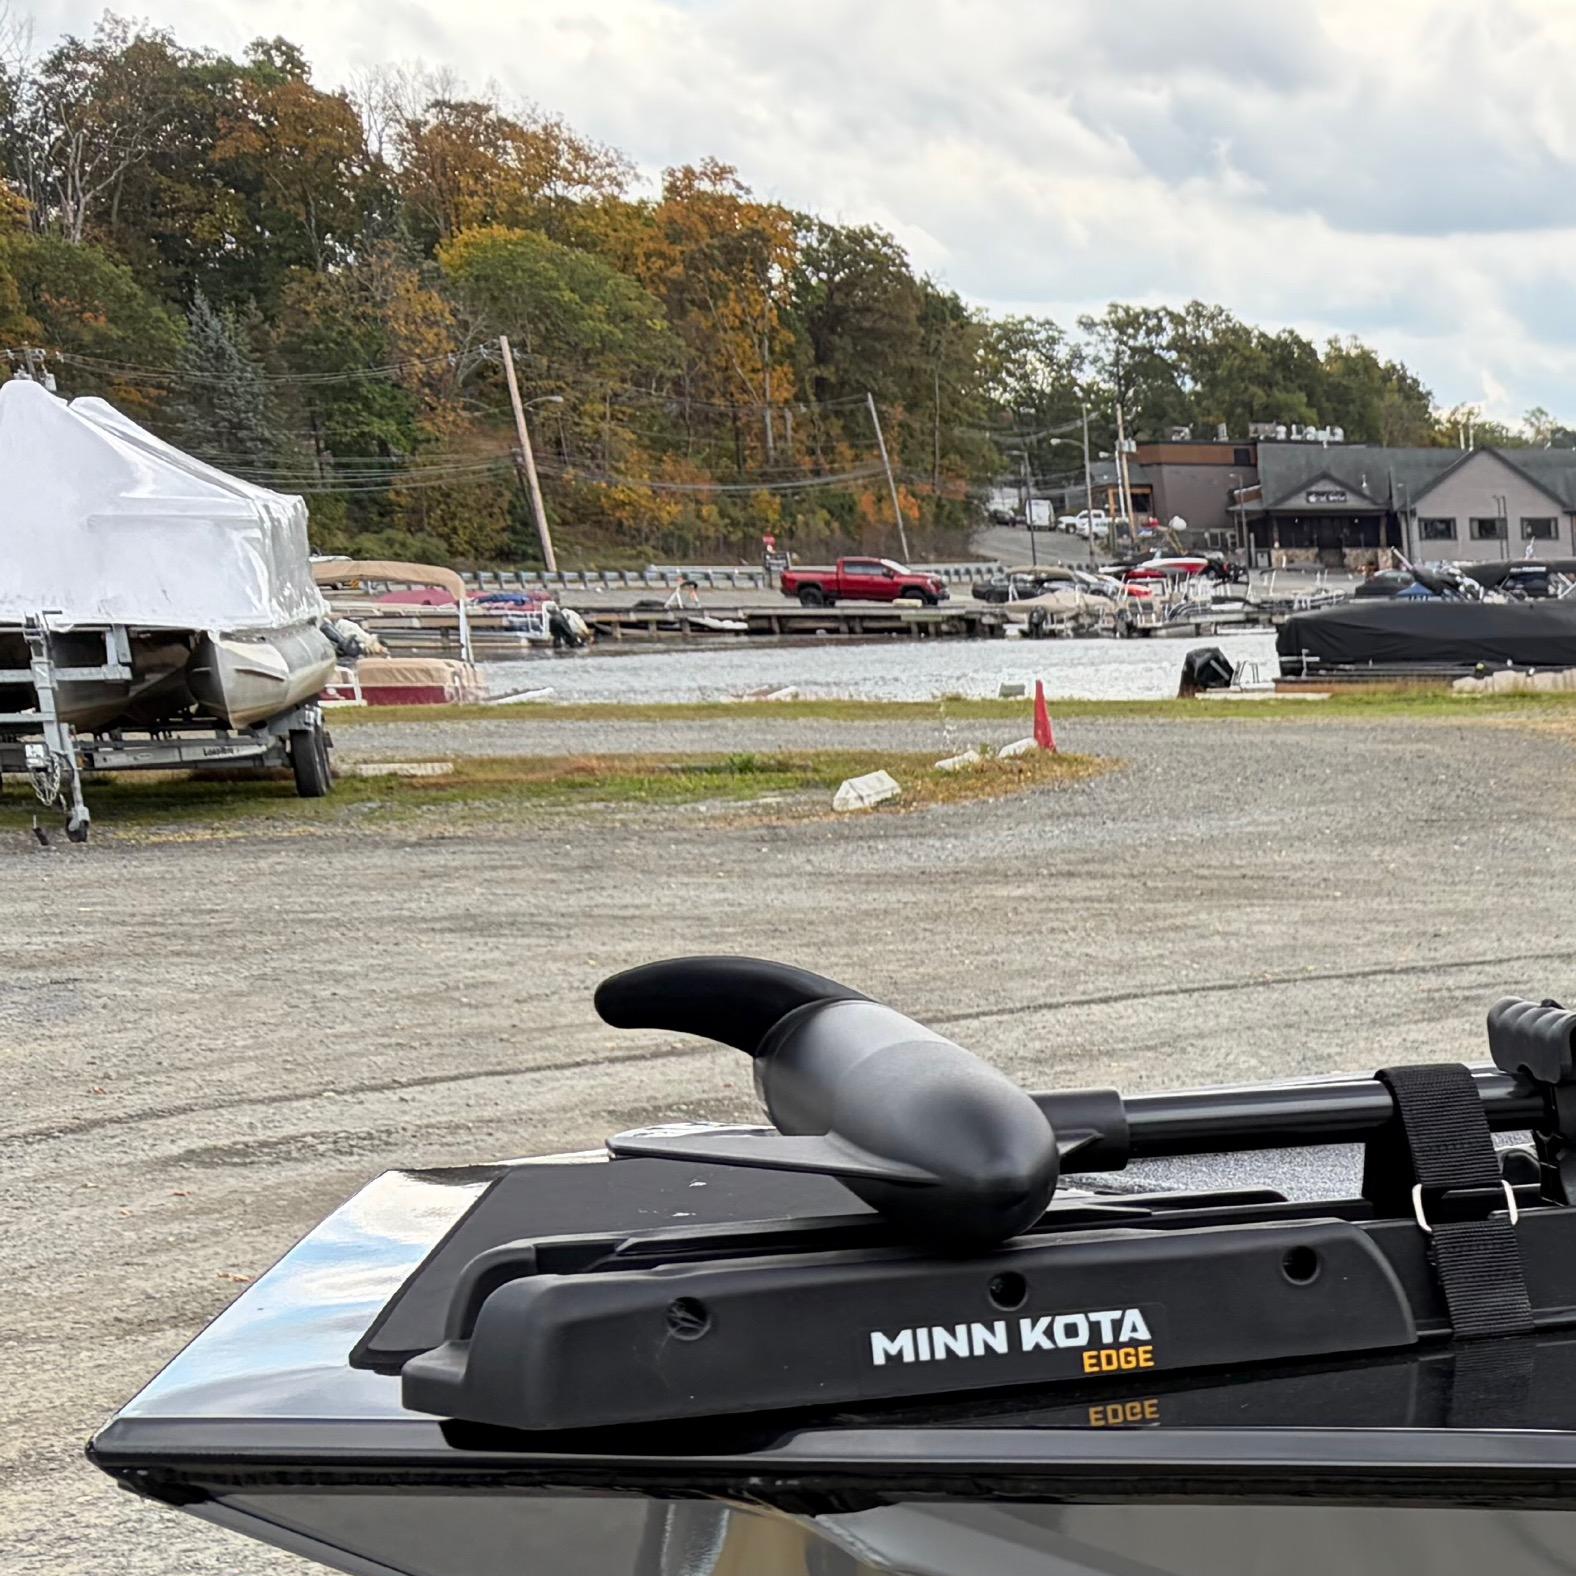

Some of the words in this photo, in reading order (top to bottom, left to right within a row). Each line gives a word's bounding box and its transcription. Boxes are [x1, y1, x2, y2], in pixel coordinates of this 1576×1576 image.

[871, 1320, 1008, 1366] MINN
[1019, 1308, 1152, 1351] KOTA
[1083, 1346, 1155, 1373] EDGE
